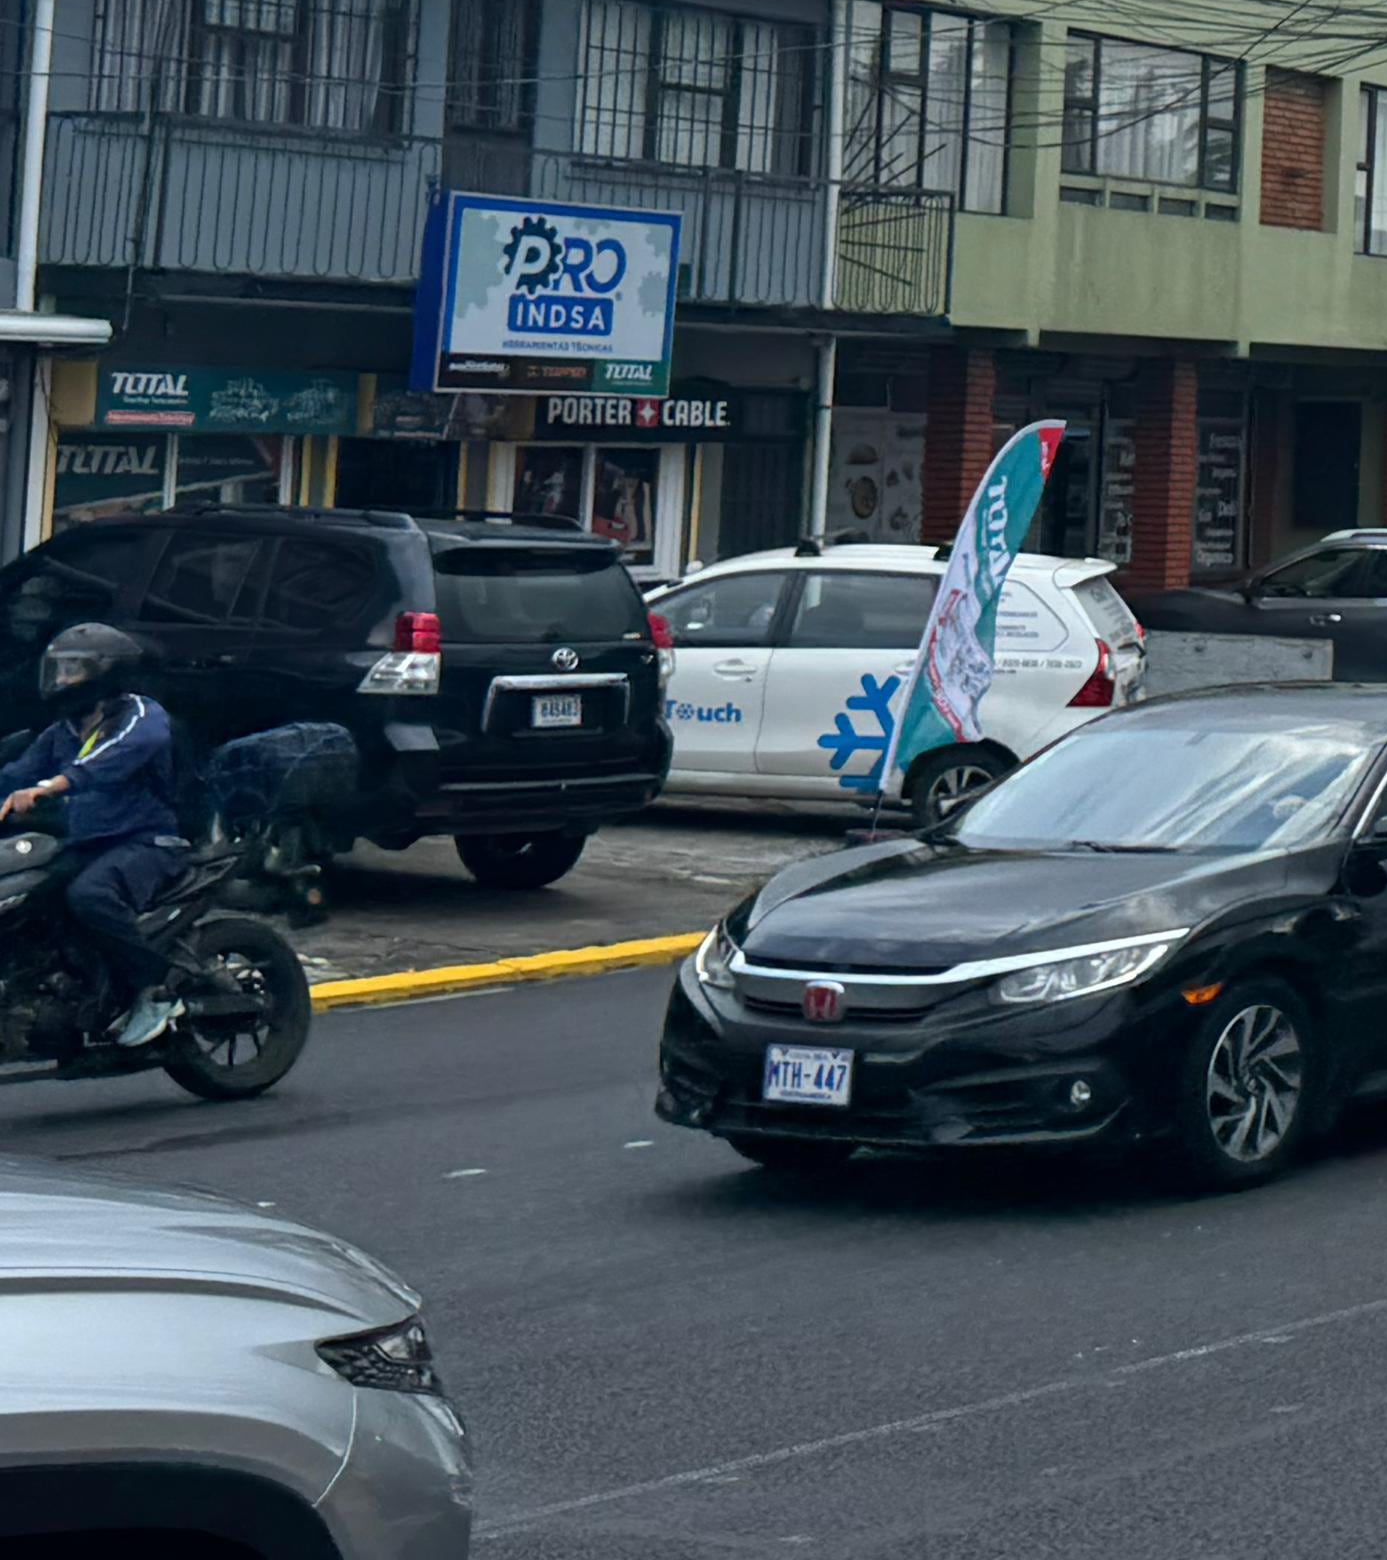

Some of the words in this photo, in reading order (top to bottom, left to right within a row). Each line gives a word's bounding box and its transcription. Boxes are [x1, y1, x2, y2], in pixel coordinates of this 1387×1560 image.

[508, 231, 627, 295] PRO
[516, 301, 606, 331] INDSA
[111, 371, 189, 396] TOTAL
[605, 363, 653, 380] TOTAL
[547, 396, 632, 425] PORTER
[56, 443, 159, 475] TOTAL
[767, 1060, 847, 1092] MTH-447
